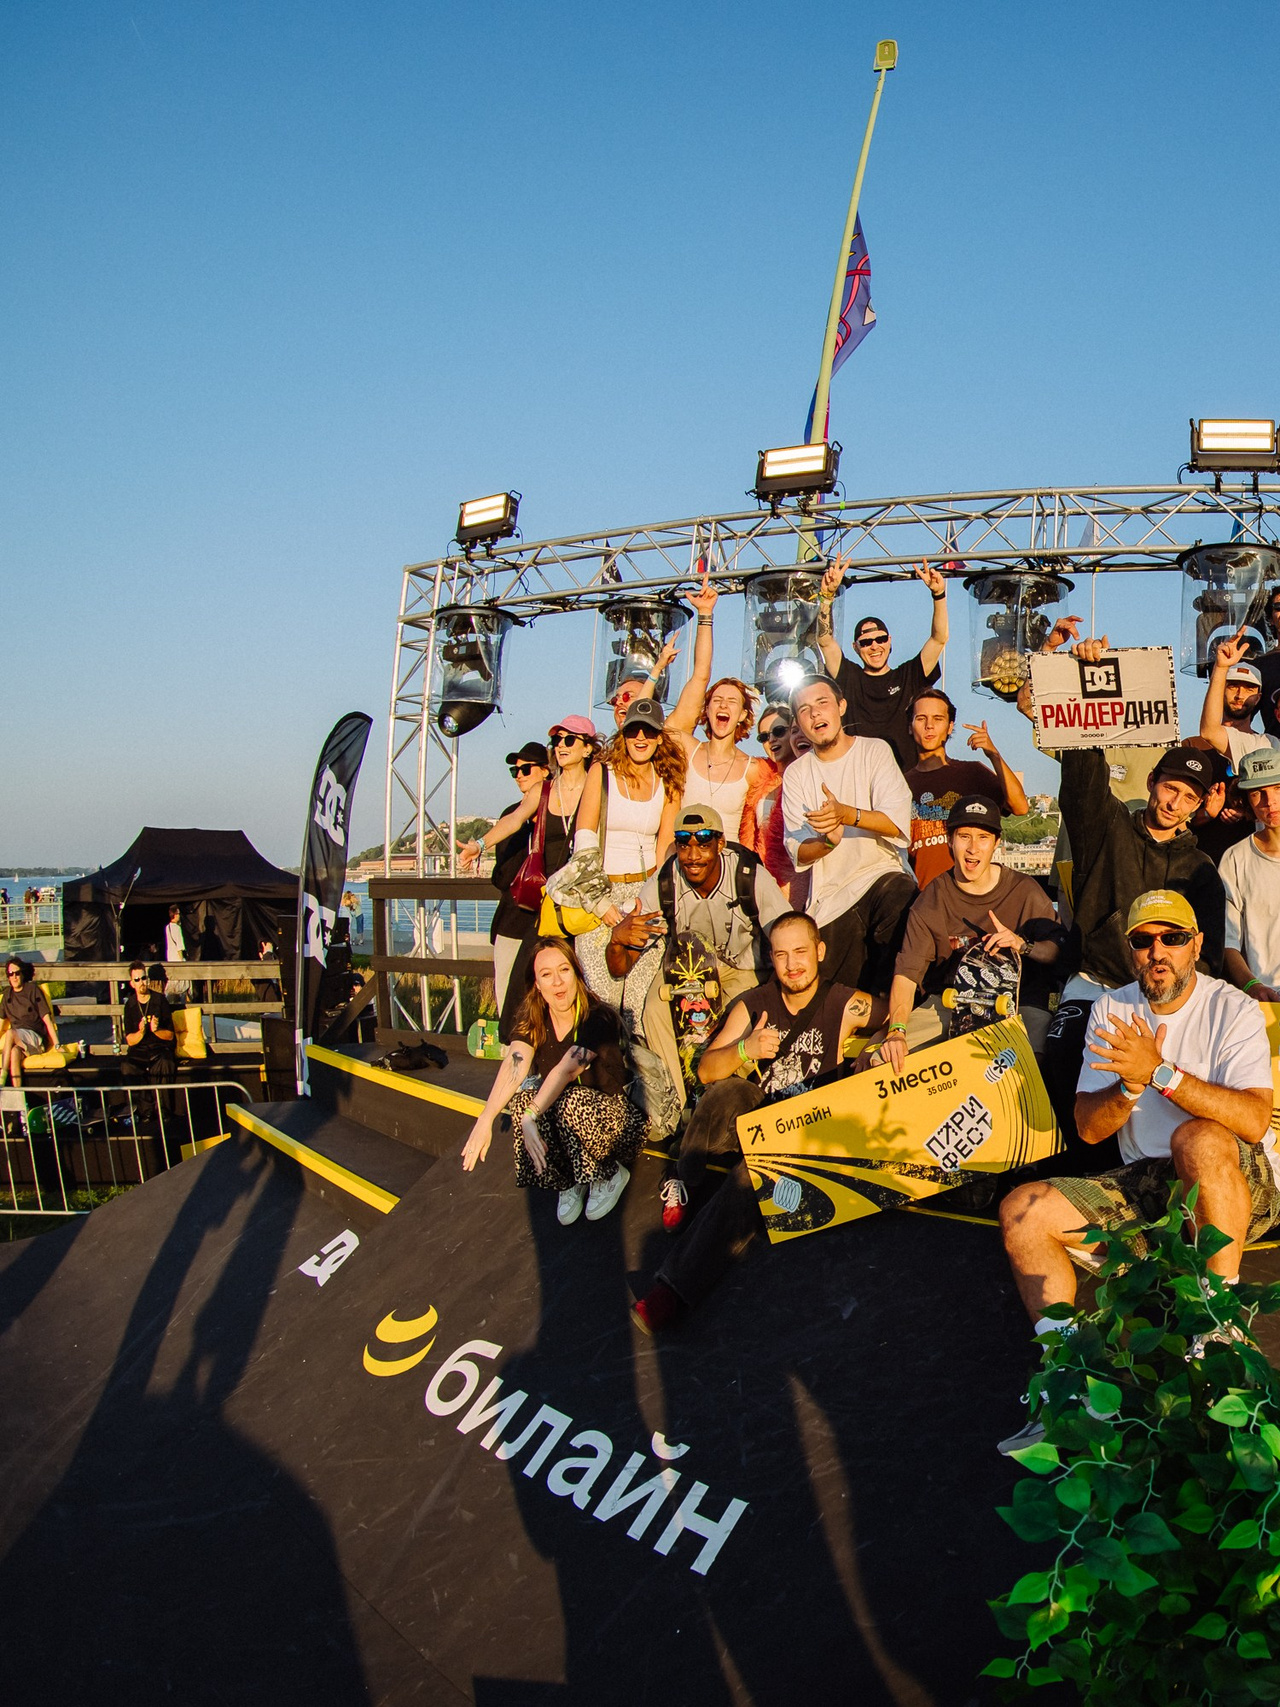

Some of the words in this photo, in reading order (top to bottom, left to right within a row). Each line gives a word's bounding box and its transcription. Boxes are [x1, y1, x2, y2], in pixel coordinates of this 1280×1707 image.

[875, 1080, 889, 1099] 3
[889, 1061, 953, 1095] место
[775, 1106, 833, 1135] билайн
[425, 1339, 750, 1576] билайн
